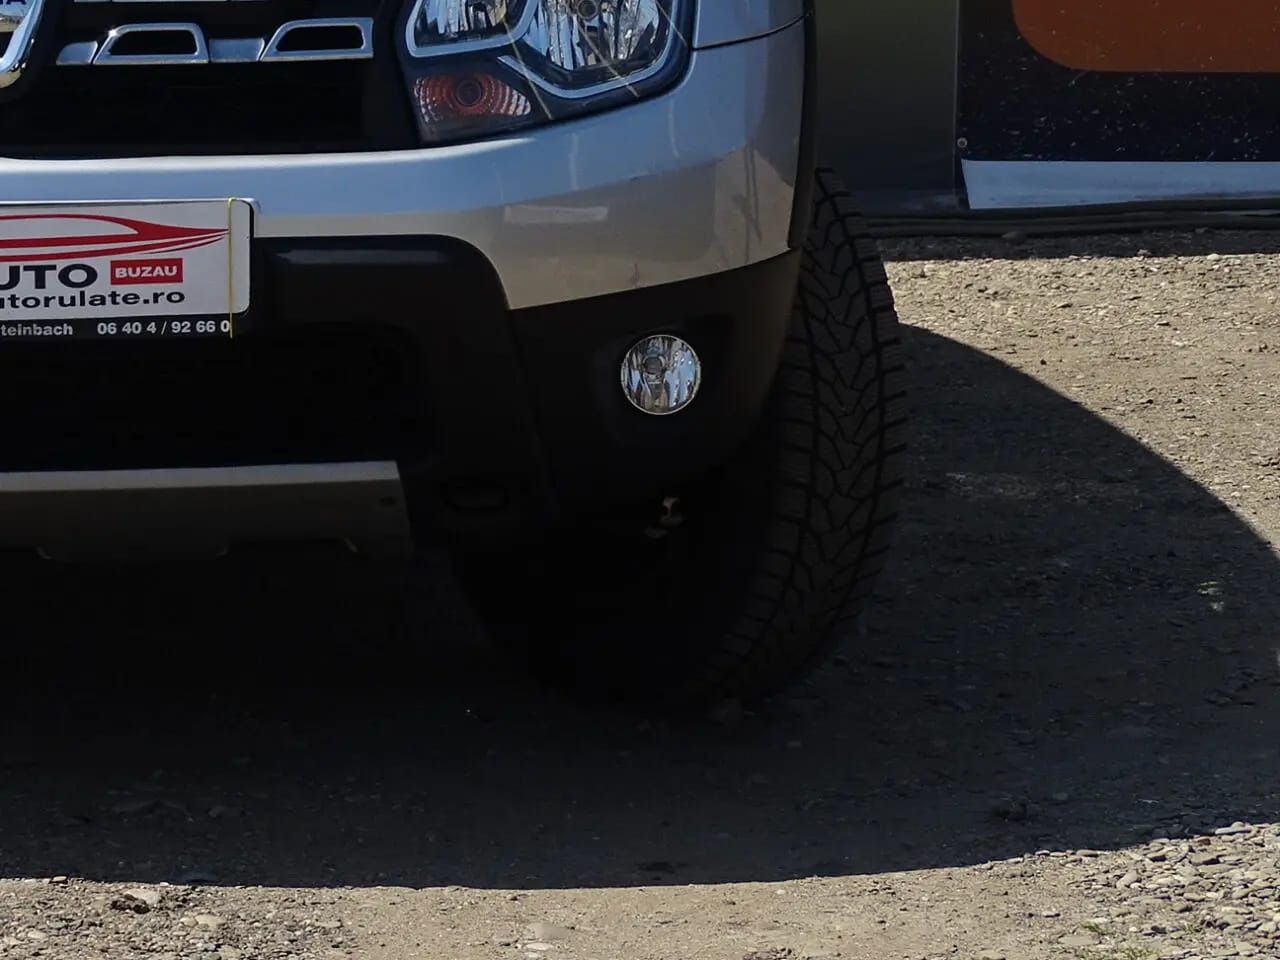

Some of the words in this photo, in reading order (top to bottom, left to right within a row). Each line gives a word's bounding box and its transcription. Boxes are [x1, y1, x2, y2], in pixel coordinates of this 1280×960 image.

[114, 265, 178, 279] BUZAU
[97, 322, 118, 335] 06
[121, 322, 143, 334] 40
[146, 321, 157, 333] 4
[171, 321, 192, 334] 92
[195, 320, 217, 333] 66
[220, 319, 231, 333] 0
